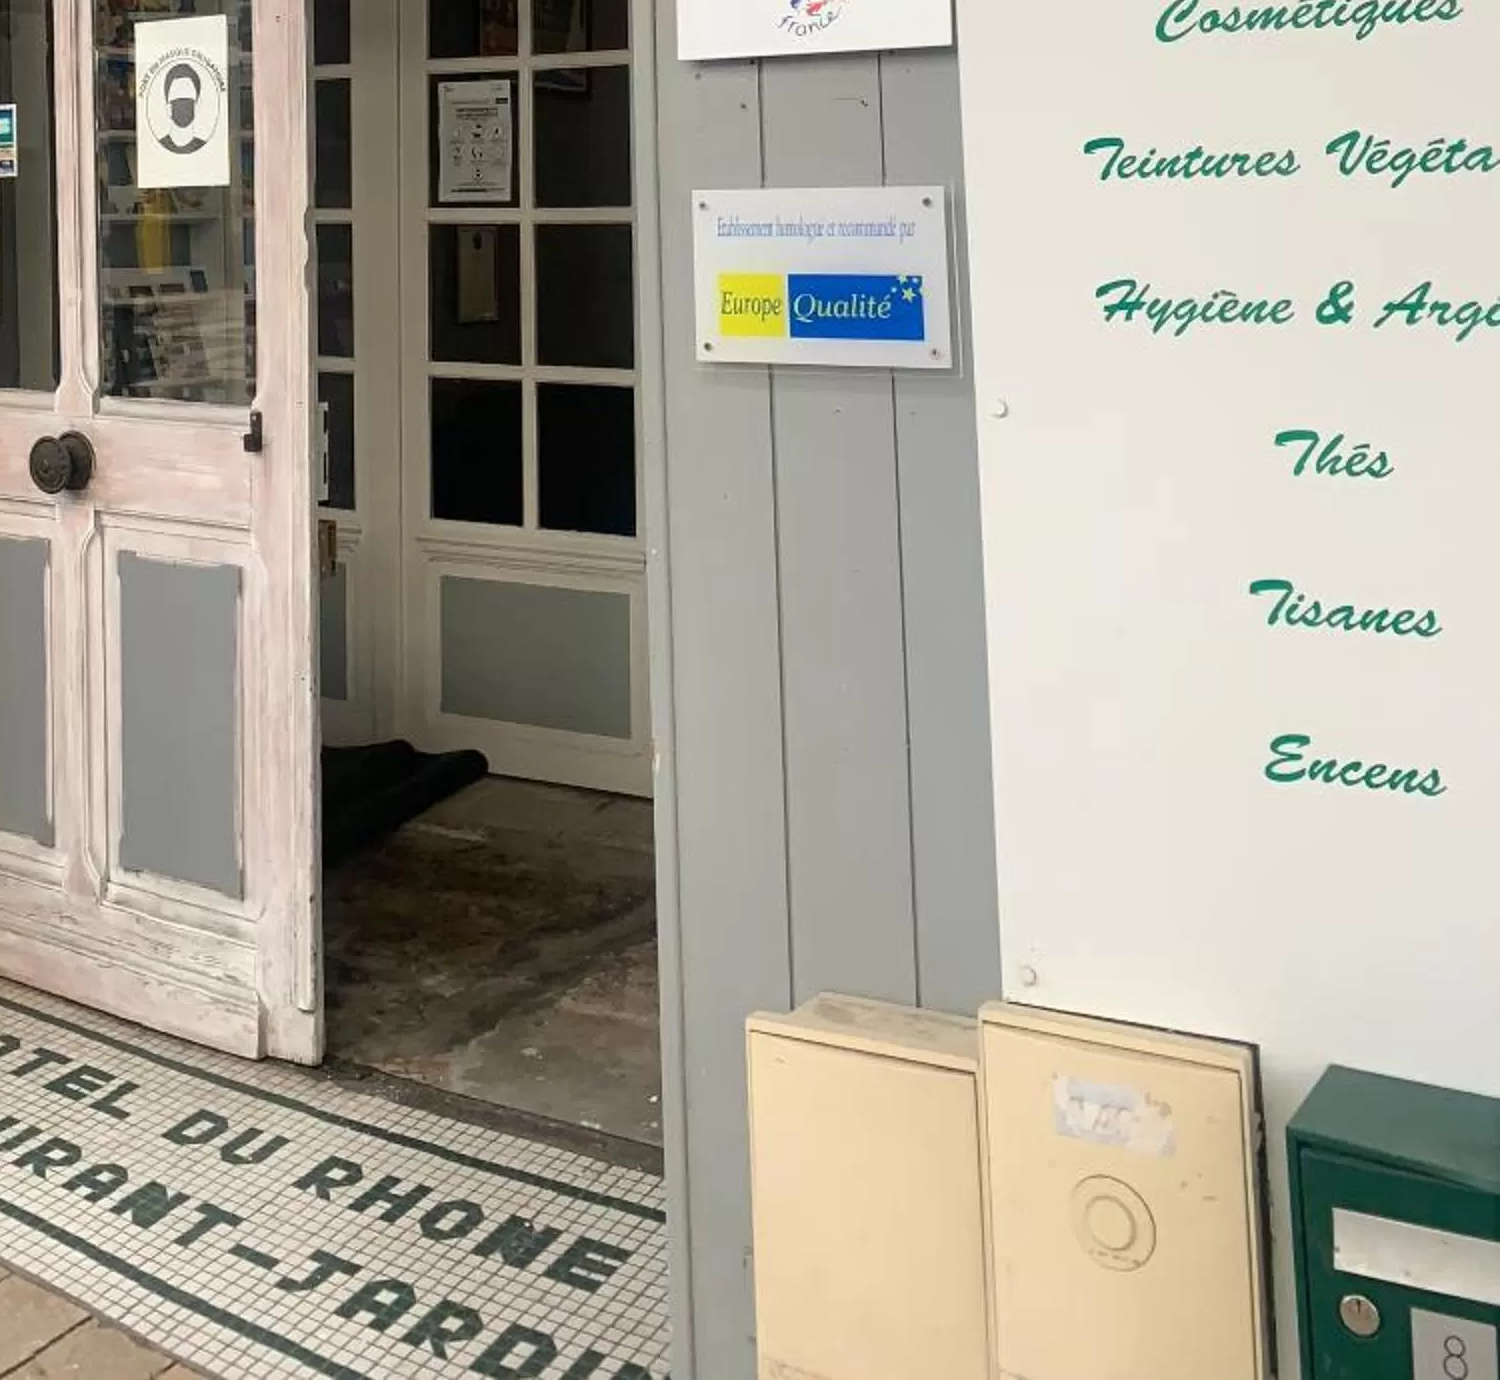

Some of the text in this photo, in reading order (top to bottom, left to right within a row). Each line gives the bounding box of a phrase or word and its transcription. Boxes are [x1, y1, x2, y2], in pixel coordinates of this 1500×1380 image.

[1083, 137, 1301, 181] Teintures
[720, 291, 892, 323] Europe Qualité
[1095, 279, 1295, 337] Hygiène
[1315, 280, 1355, 324] &
[1274, 429, 1394, 479] Thés
[1249, 579, 1443, 637] Tisanes
[1264, 733, 1448, 797] Encens
[162, 1109, 290, 1165] DU
[291, 1155, 634, 1294] RHONE
[1444, 1334, 1469, 1380] 8
